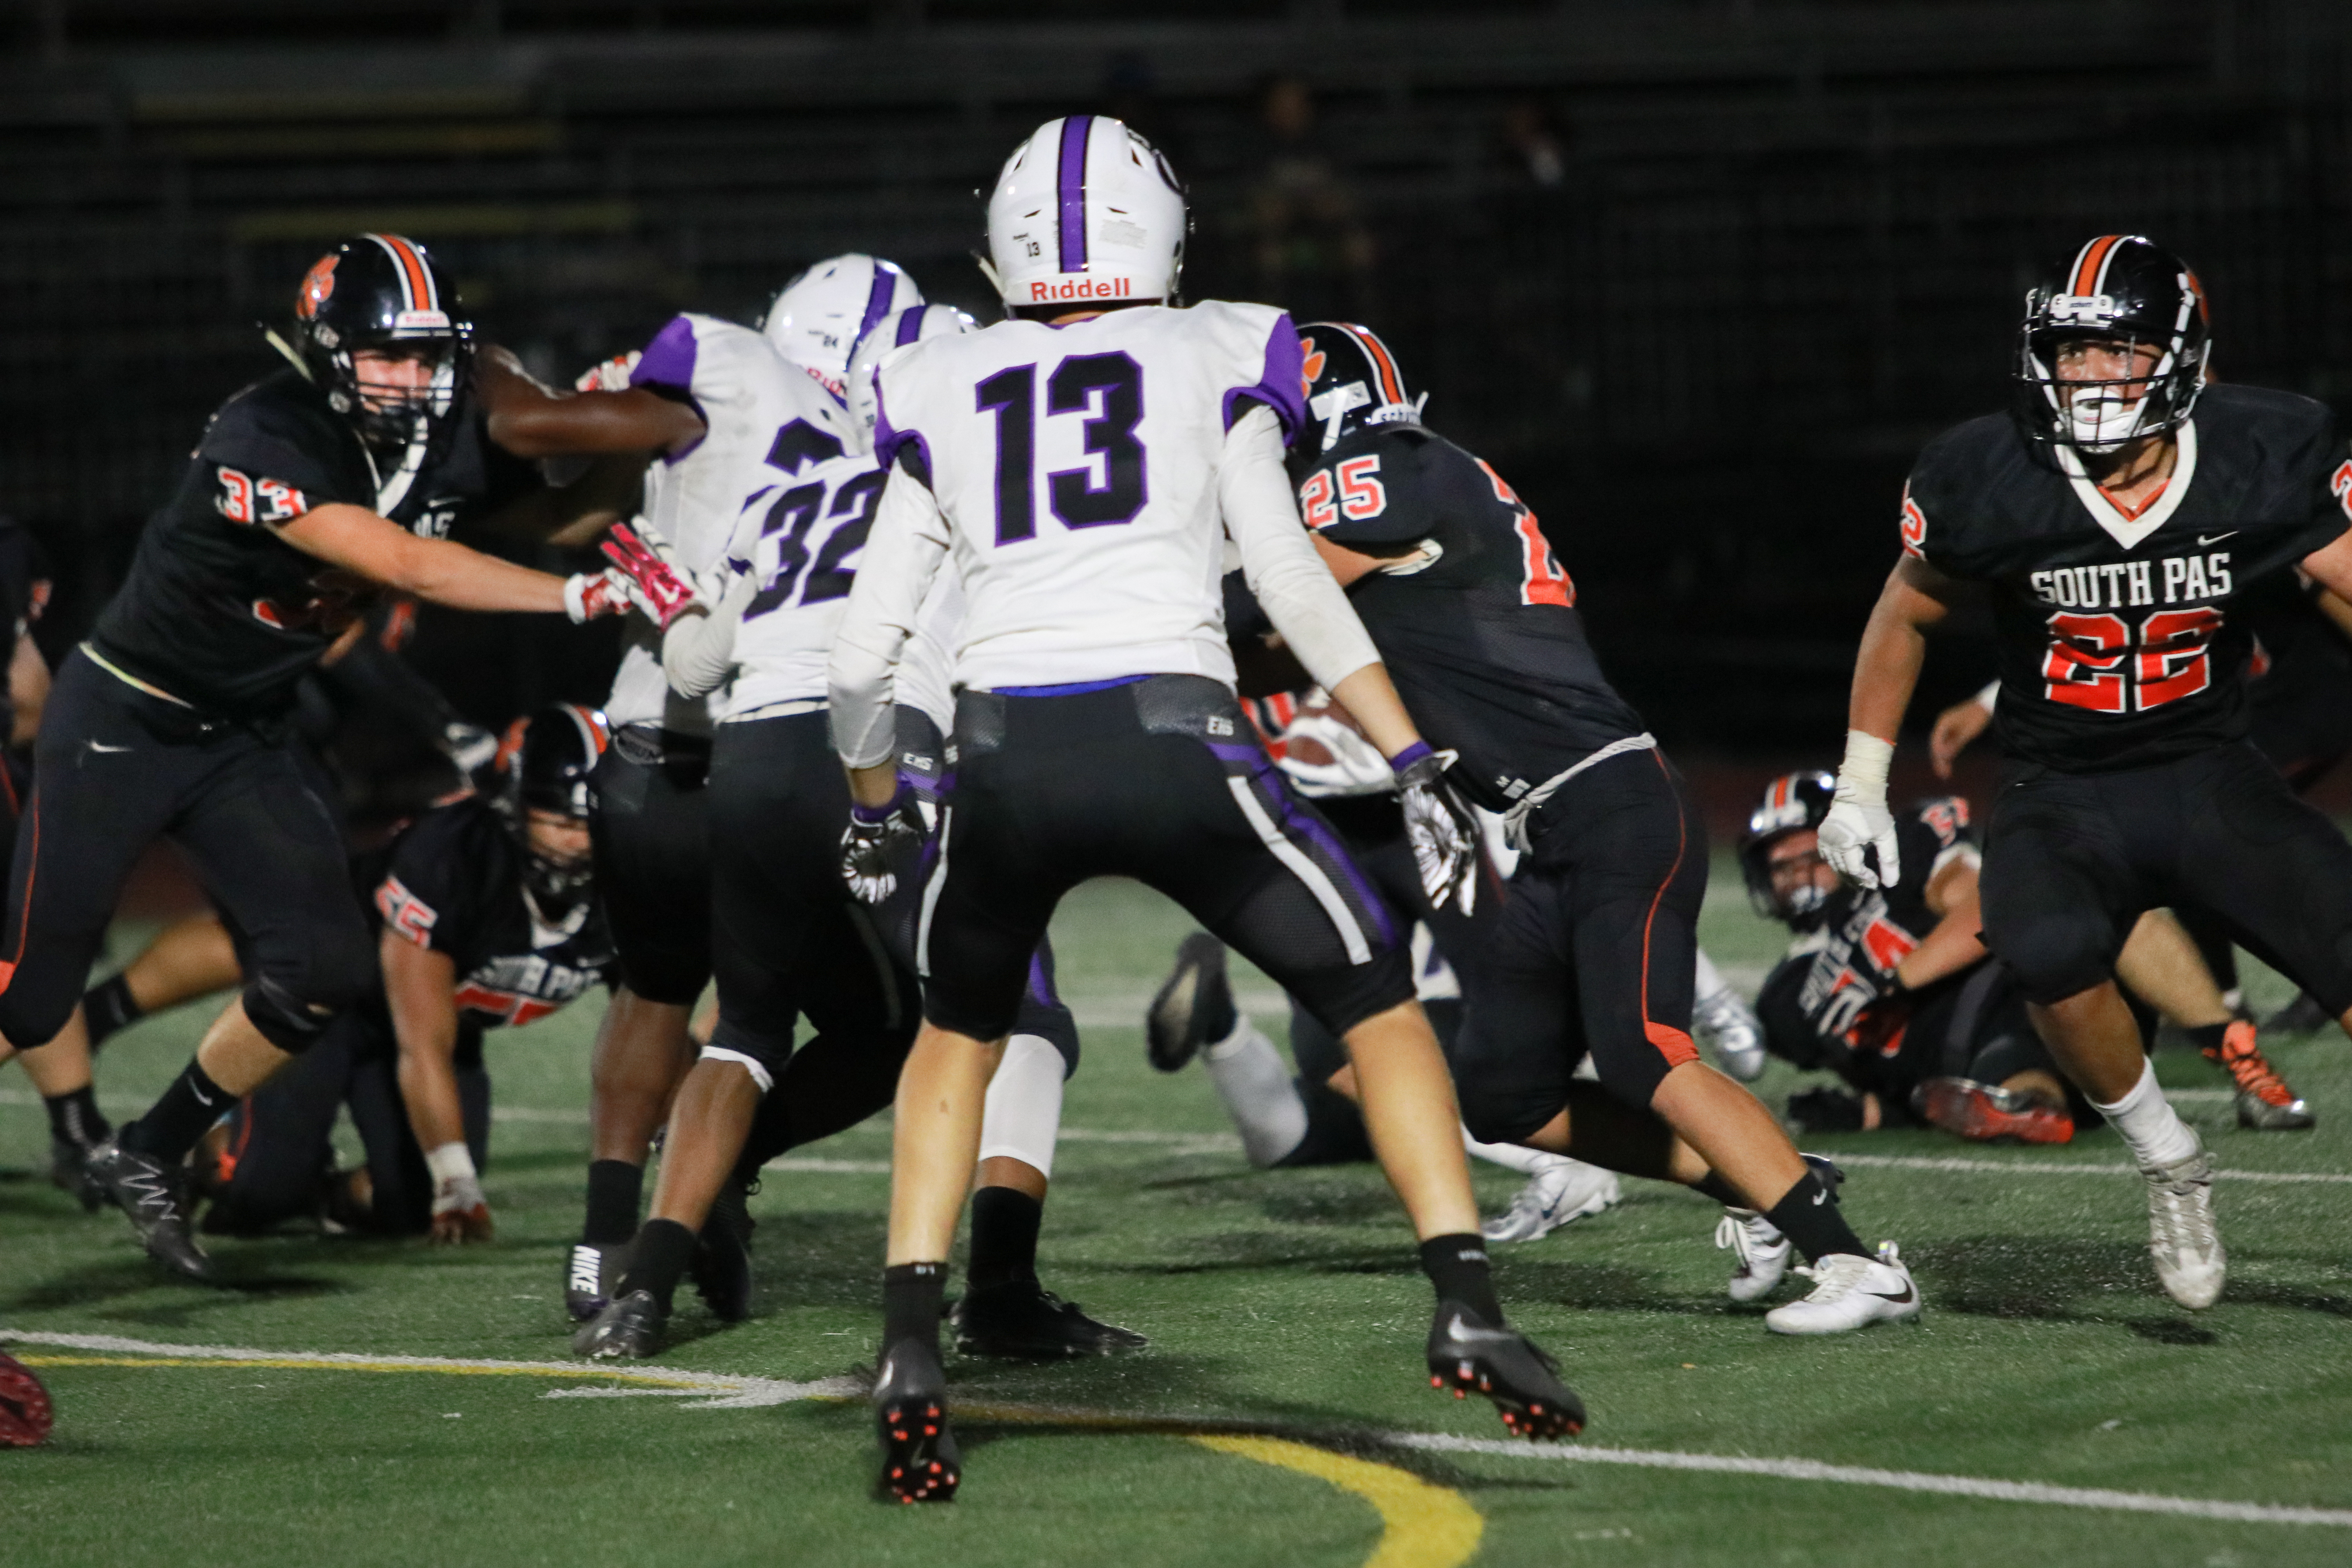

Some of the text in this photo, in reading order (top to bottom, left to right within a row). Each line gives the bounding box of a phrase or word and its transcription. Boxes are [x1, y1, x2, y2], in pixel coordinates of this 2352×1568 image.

[1026, 241, 1040, 257] 13
[1031, 278, 1130, 301] Riddell
[975, 350, 1149, 548] 13
[215, 466, 308, 524] 33
[1299, 454, 1387, 529] 25
[742, 468, 889, 623] 32
[2031, 553, 2232, 608] SOUTH PAS
[2042, 606, 2225, 713] 22
[571, 1245, 602, 1295] NIKE
